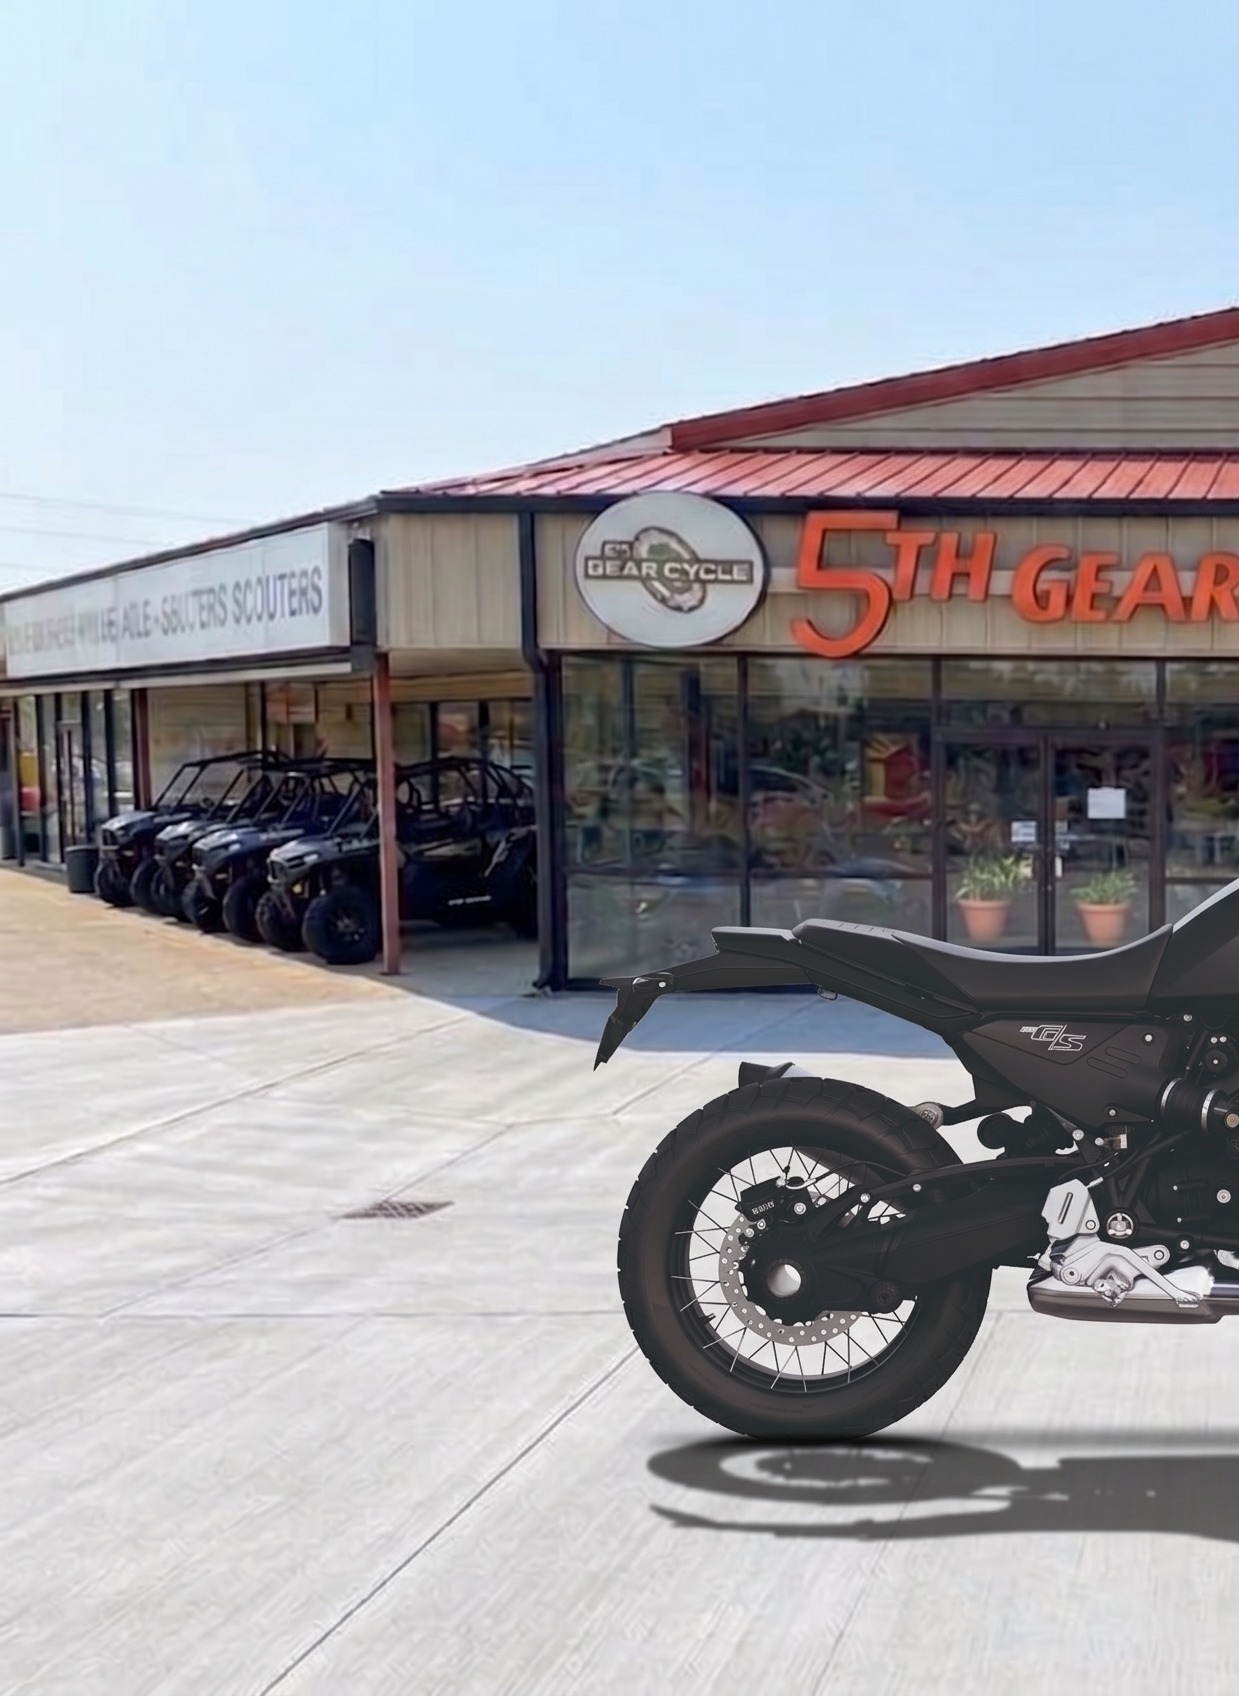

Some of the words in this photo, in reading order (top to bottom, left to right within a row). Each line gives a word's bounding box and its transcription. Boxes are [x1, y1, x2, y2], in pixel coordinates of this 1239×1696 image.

[232, 564, 323, 626] SCOUTERS
[587, 559, 657, 578] GEAR
[663, 562, 749, 581] CYCLE
[789, 509, 996, 659] 5TH
